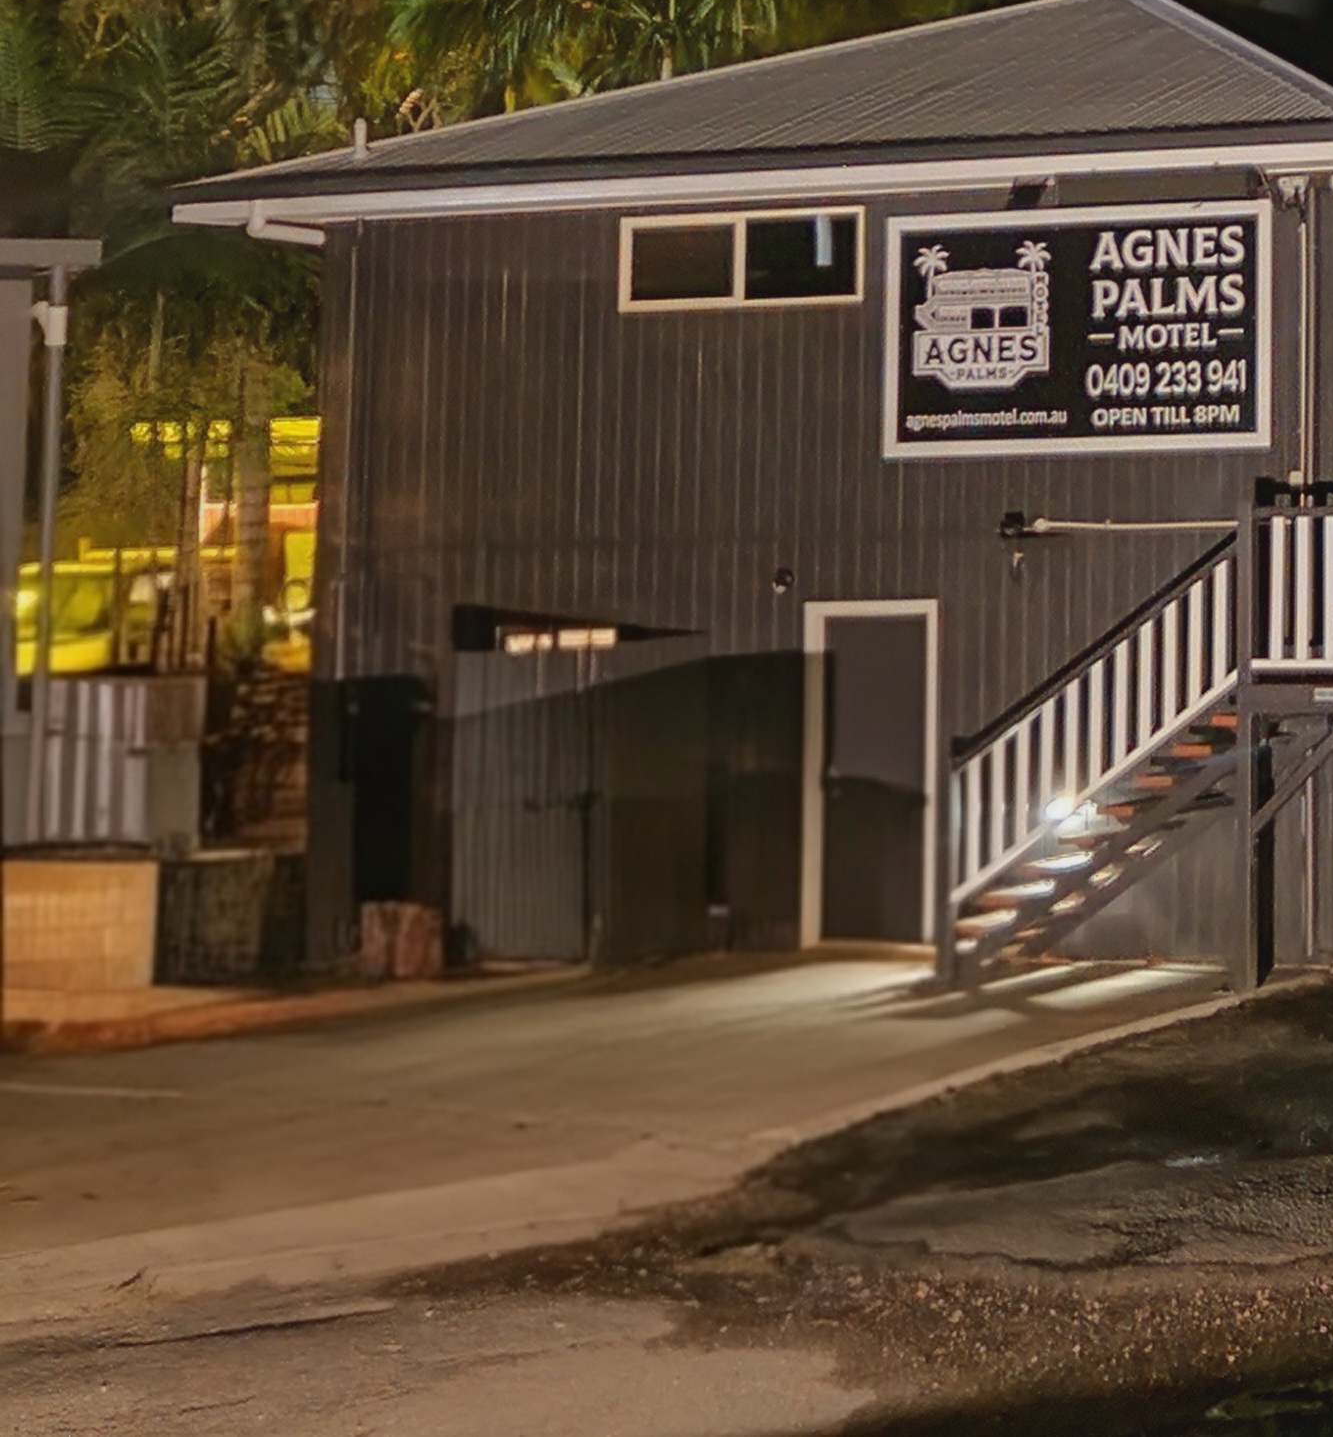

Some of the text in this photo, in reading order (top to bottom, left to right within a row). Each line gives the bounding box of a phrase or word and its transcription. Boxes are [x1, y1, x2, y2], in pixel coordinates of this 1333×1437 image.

[1089, 225, 1246, 270] AGNES
[1091, 274, 1246, 318] PALMS
[924, 335, 1038, 364] AGNES
[1117, 322, 1217, 350] MOTEL
[956, 367, 1007, 380] PALMS
[1085, 359, 1246, 398] 0409 233 941
[906, 408, 1067, 431] agnespalmsmotel.com.au
[1091, 404, 1240, 426] OPEN TILL 8PM
